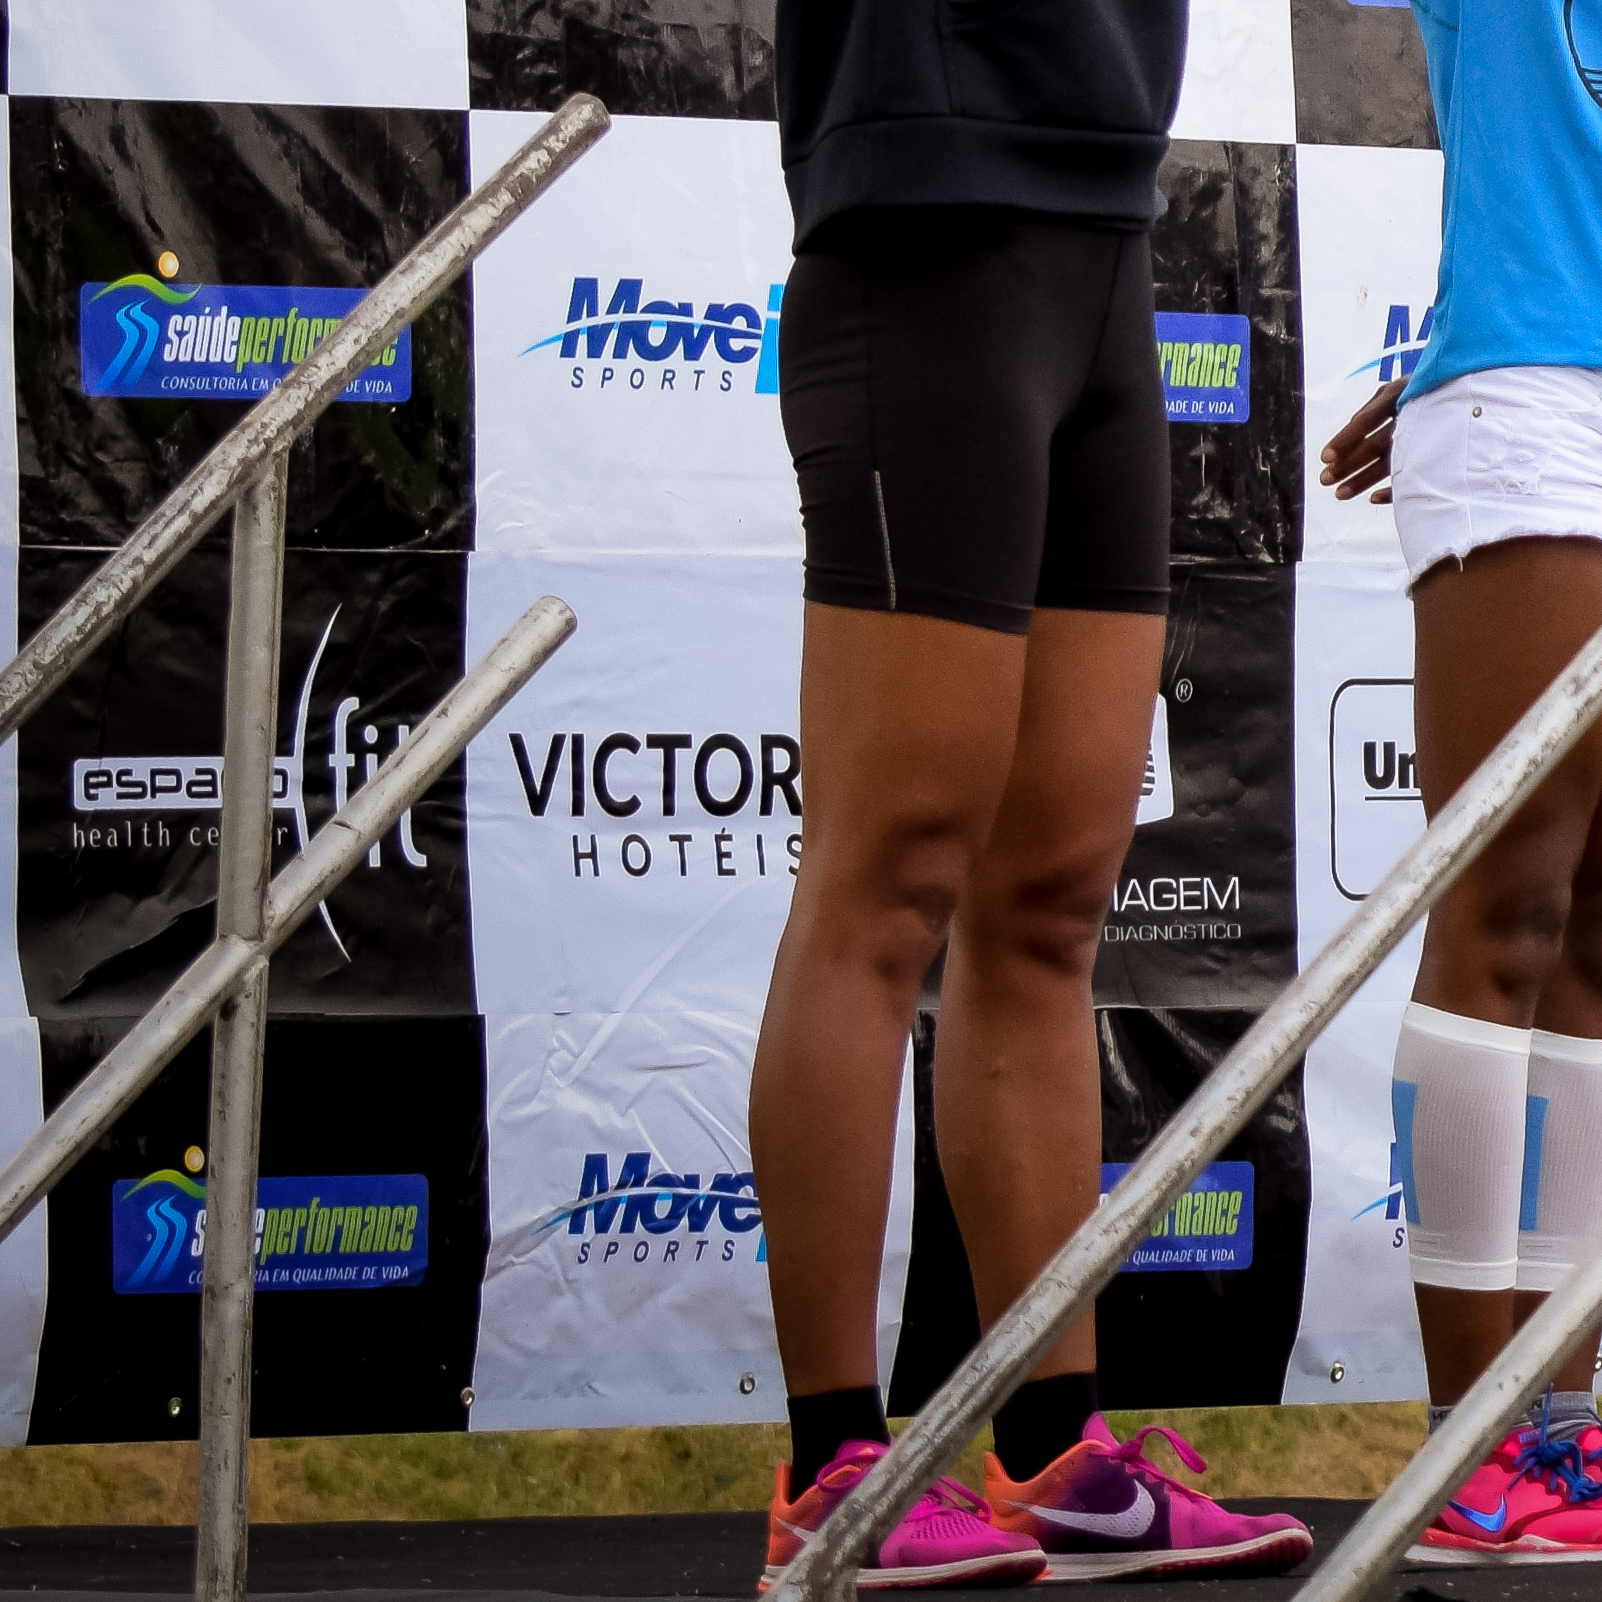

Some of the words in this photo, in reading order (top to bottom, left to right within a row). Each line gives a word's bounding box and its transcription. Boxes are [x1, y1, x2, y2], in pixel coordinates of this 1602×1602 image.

[161, 375, 249, 391] CONSULTORIA
[252, 376, 269, 391] EM
[365, 379, 393, 394] VIDA
[571, 365, 733, 393] SPORTS
[1191, 400, 1205, 414] DE
[1209, 400, 1235, 415] VIDA
[73, 820, 171, 848] health
[577, 1239, 736, 1265] SPORTS
[1132, 1248, 1193, 1265] QUALIDADE
[1196, 1248, 1208, 1263] DE
[1211, 1248, 1236, 1262] VIDA
[272, 1268, 290, 1283] EM
[293, 1266, 360, 1284] QUALIDADE
[362, 1266, 377, 1280] DE
[382, 1265, 409, 1280] VIDA
